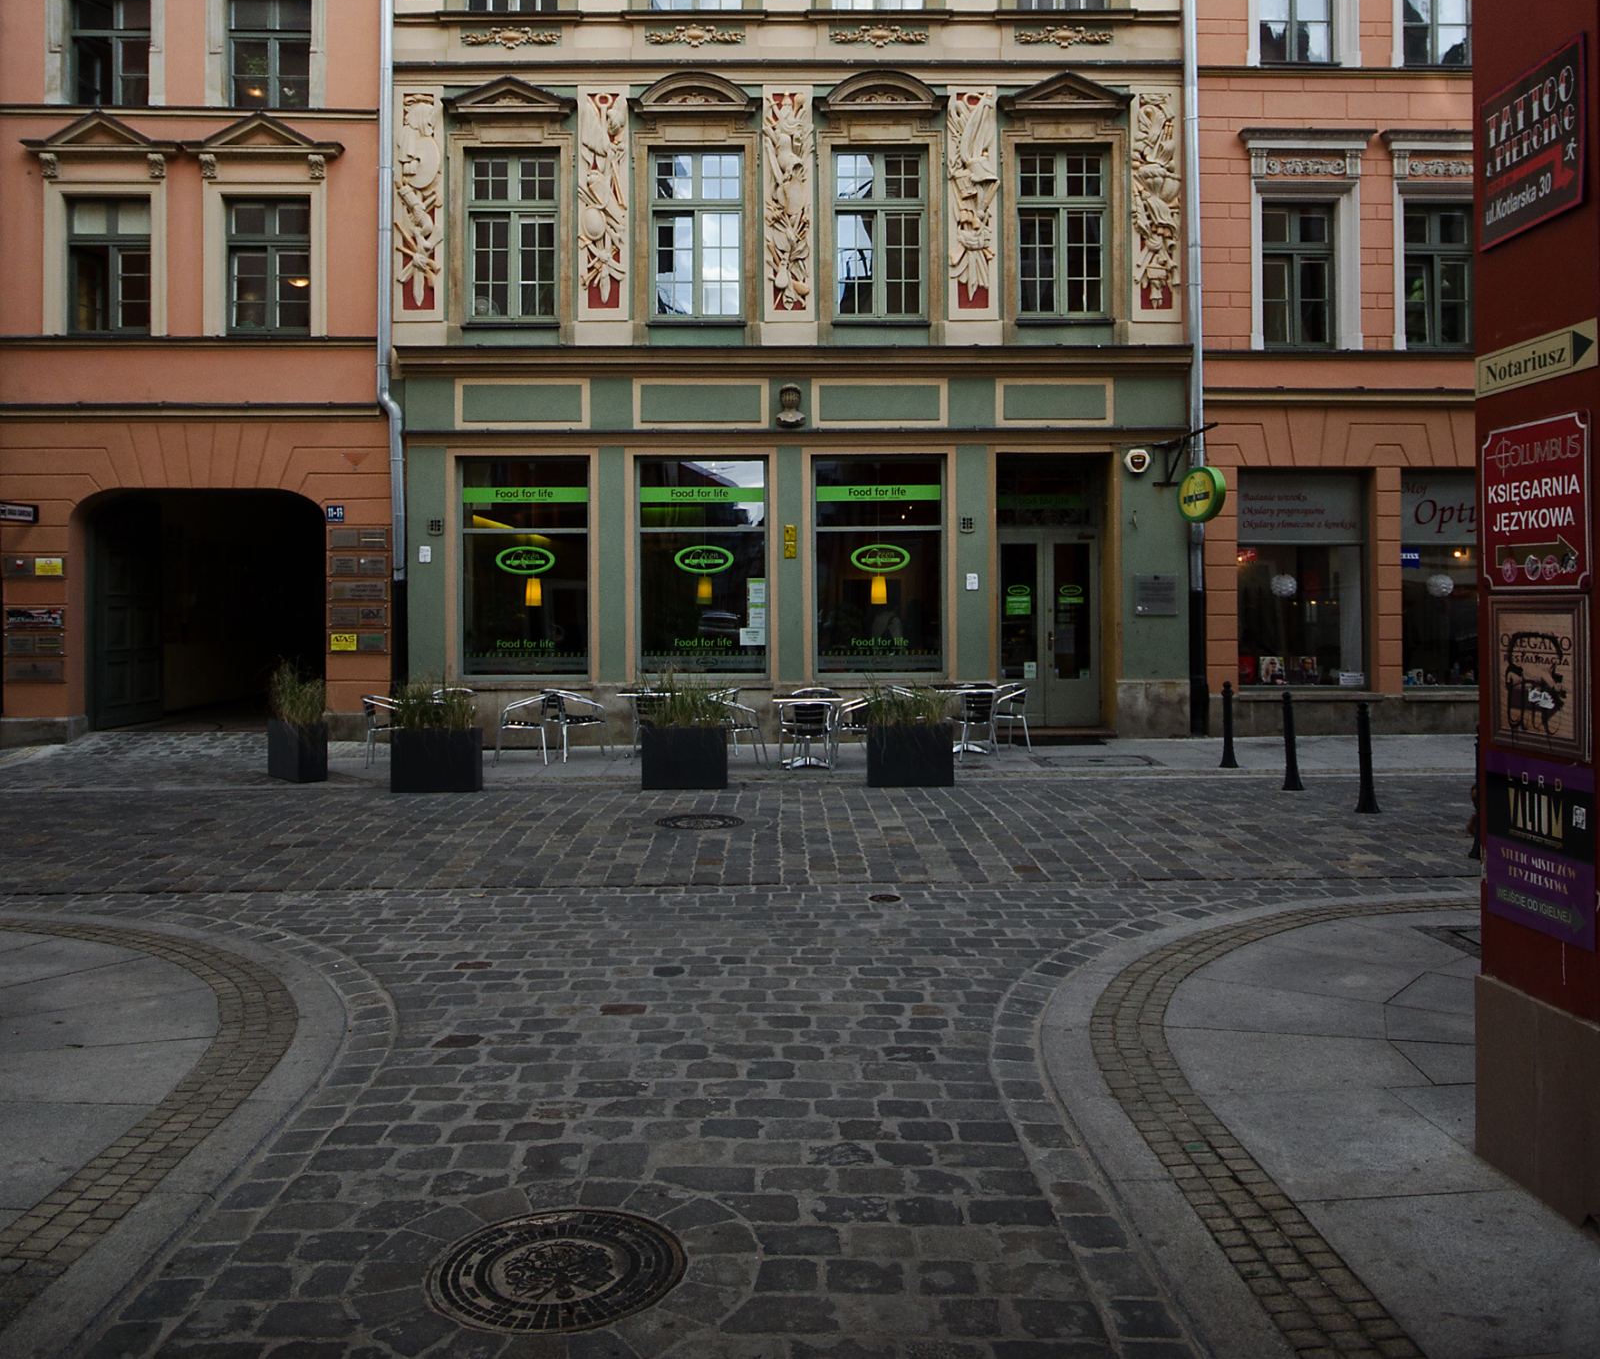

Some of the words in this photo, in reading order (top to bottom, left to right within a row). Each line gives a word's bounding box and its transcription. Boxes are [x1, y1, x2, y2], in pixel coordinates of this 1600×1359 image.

[1486, 65, 1574, 148] TATTOO
[1495, 104, 1575, 172] PIERCING
[1538, 172, 1552, 198] 30
[1486, 347, 1566, 384] Notariusz
[495, 489, 519, 499] Food
[522, 489, 536, 499] for
[538, 489, 554, 499] life
[670, 488, 694, 498] Food
[697, 488, 711, 498] for
[713, 488, 729, 498] life
[848, 487, 872, 497] Food
[875, 487, 888, 497] for
[891, 487, 906, 497] life
[1487, 474, 1581, 506] KSIĘGARNIA
[1493, 506, 1576, 537] JĘZYKOWA
[496, 639, 520, 649] Food
[523, 639, 537, 649] for
[539, 639, 555, 649] life
[674, 637, 698, 648] Food
[701, 637, 714, 648] for
[717, 637, 733, 648] life
[851, 637, 875, 647] Food
[878, 637, 891, 647] for
[894, 637, 910, 647] life
[1503, 653, 1570, 666] RSTAURACJA
[1507, 769, 1562, 792] LORD
[1506, 787, 1563, 839] VALIUM
[1496, 885, 1526, 908] WEJŚCIE
[1527, 898, 1538, 912] OD
[1539, 902, 1571, 925] IGIELNEJ
